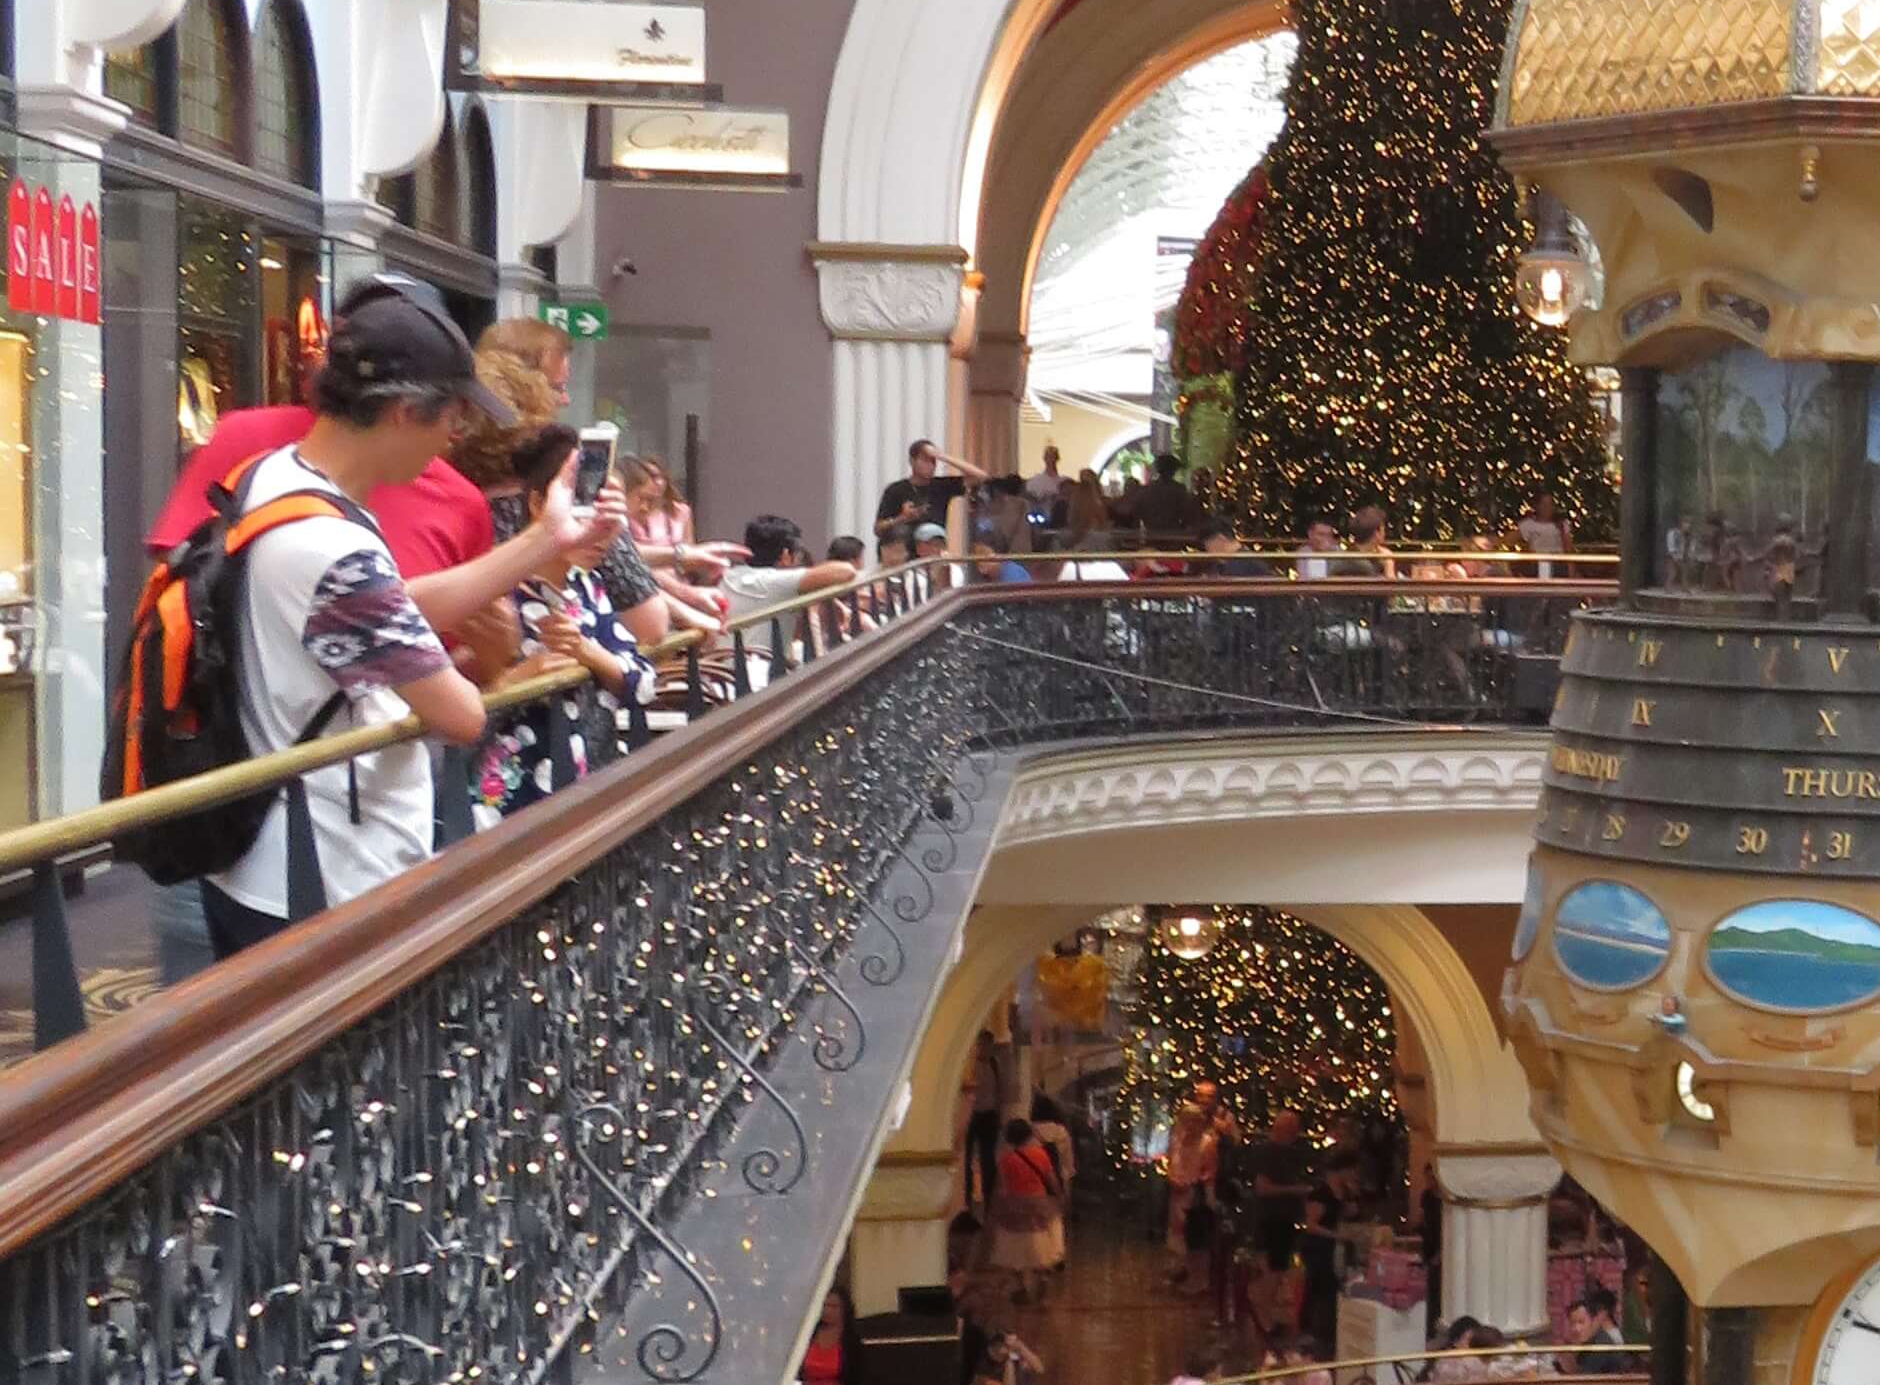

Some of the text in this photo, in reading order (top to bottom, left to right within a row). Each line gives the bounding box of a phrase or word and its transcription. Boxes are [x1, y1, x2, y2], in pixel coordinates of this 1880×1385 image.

[13, 224, 97, 293] SALE
[1638, 638, 1664, 666] IV
[1827, 647, 1849, 674] V
[1815, 709, 1841, 737] X
[1659, 820, 1691, 848] 29
[1735, 827, 1769, 855] 30
[1826, 830, 1851, 860] 31
